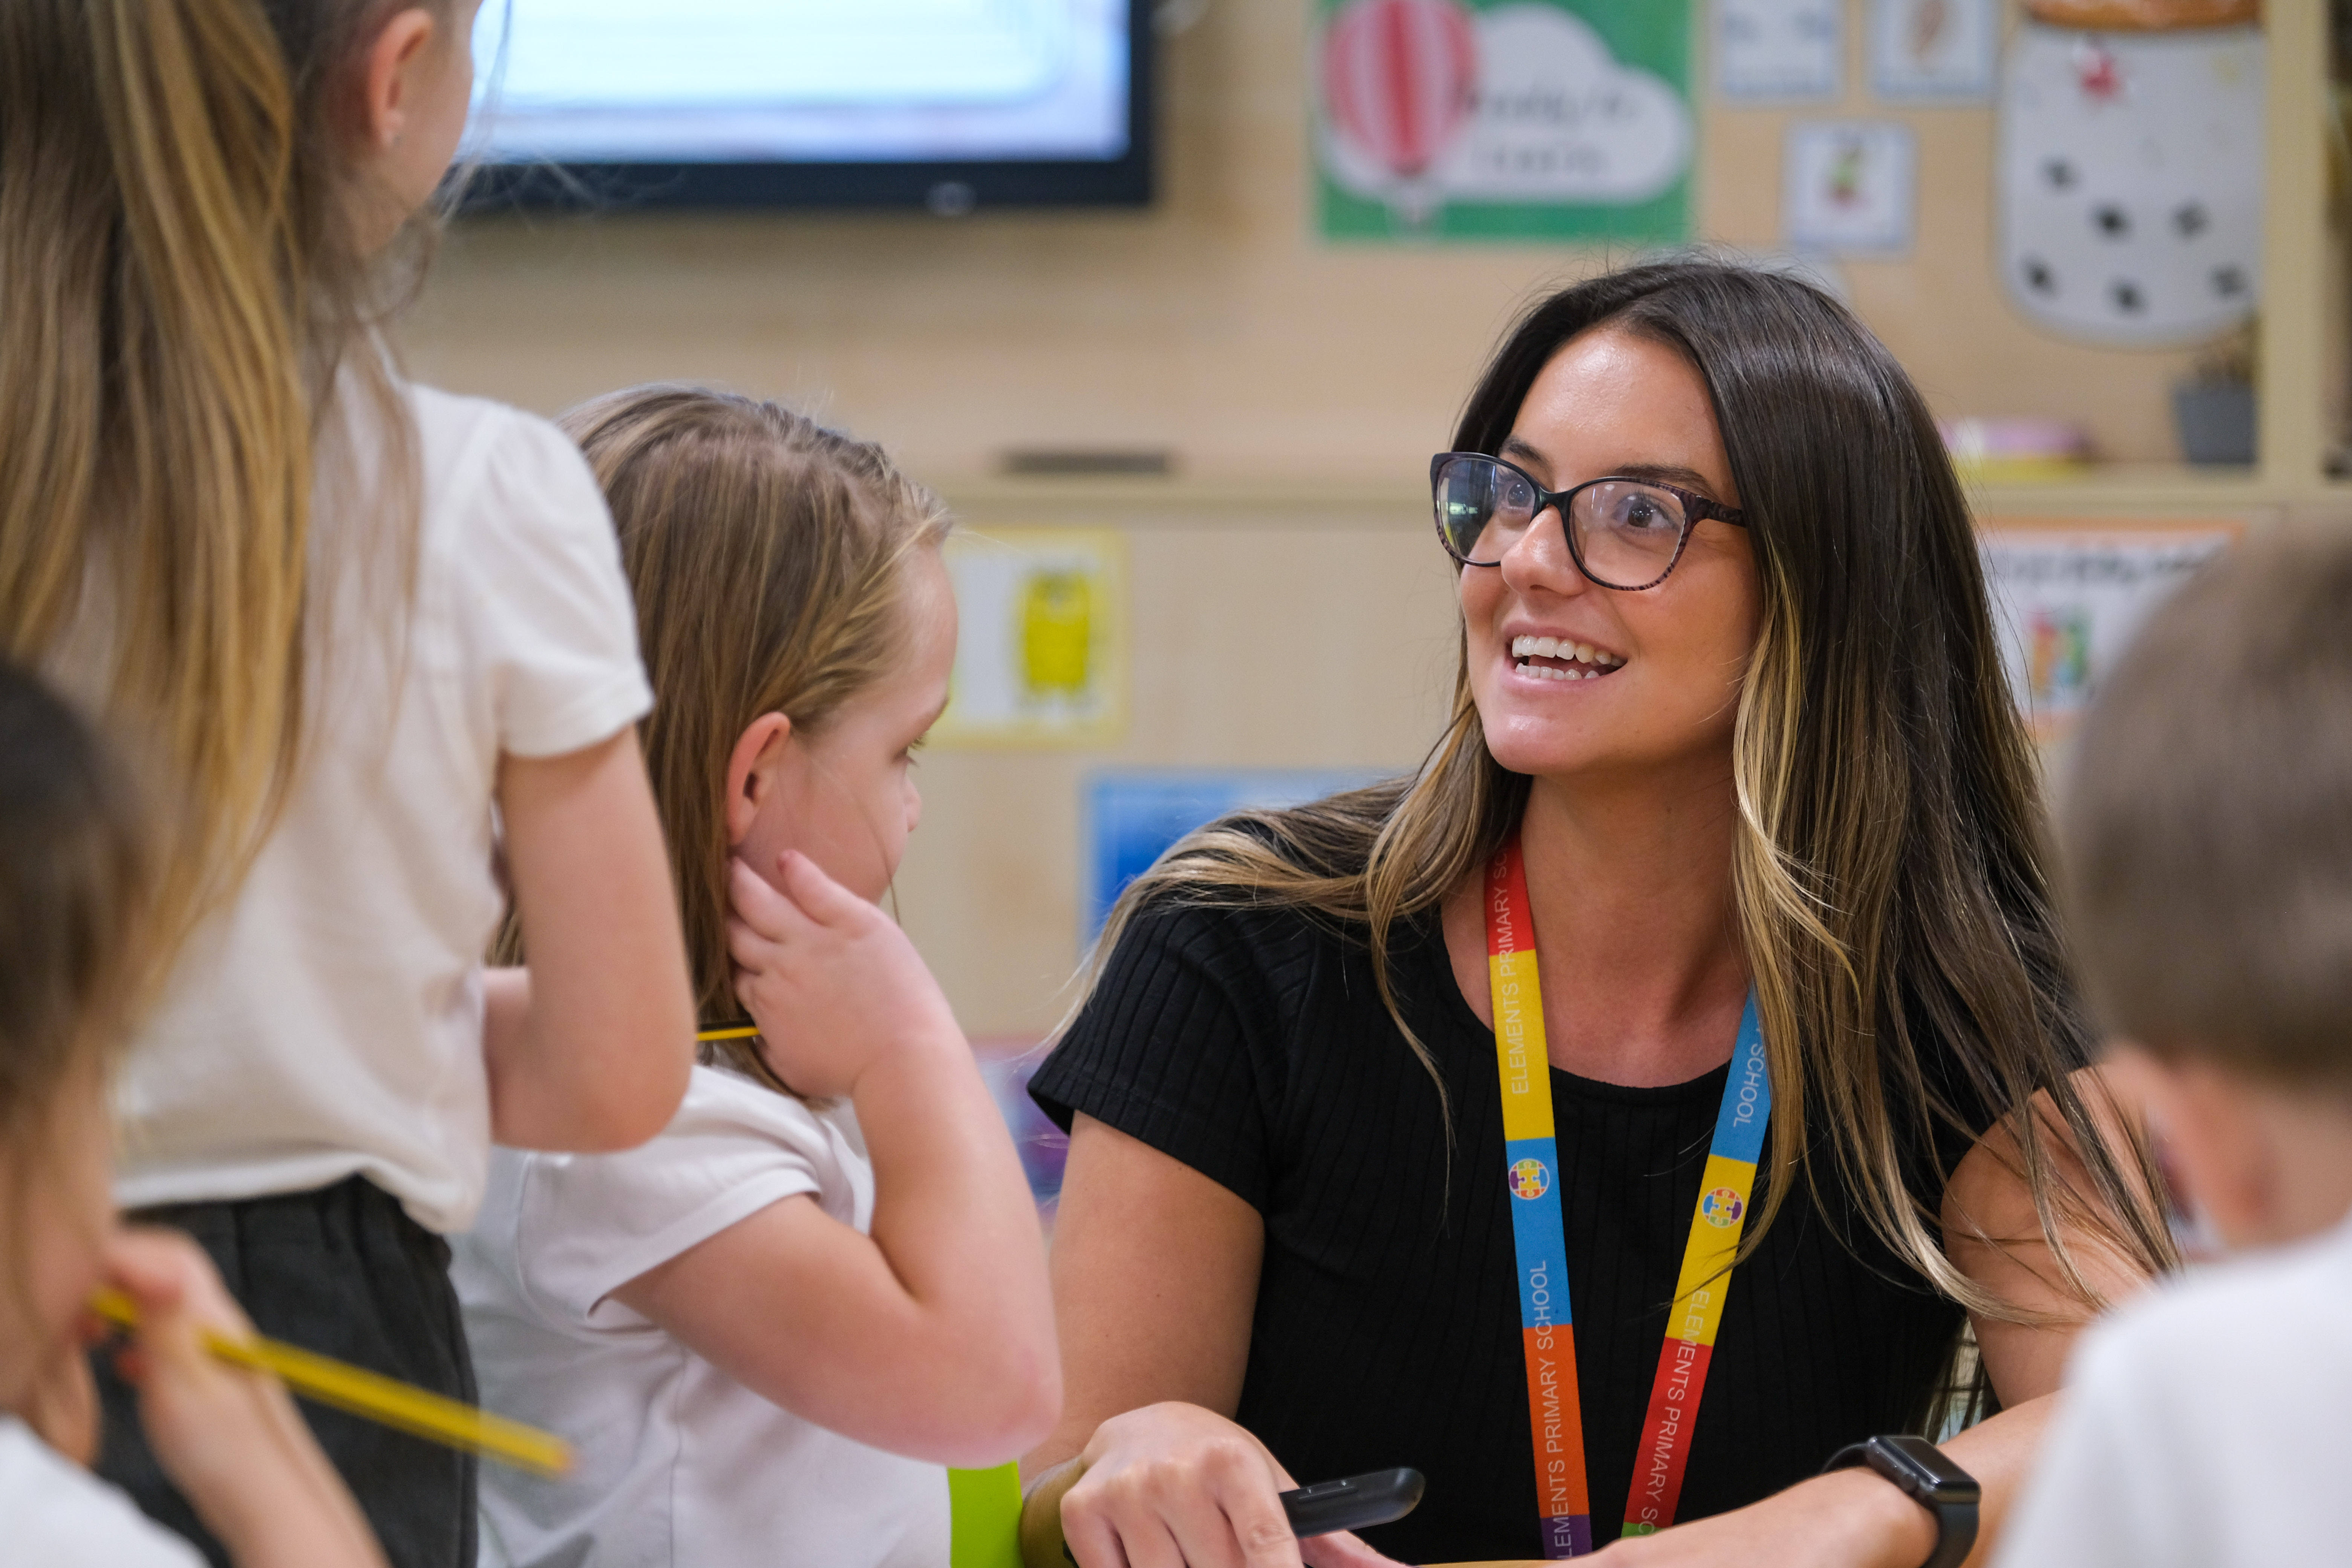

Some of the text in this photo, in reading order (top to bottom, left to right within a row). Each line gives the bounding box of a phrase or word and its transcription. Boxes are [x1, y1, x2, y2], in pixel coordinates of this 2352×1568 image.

[1494, 887, 1517, 977] PRIMARY
[1502, 982, 1529, 1095] ELEMENTS
[1733, 1043, 1765, 1128] SCHOOL
[1668, 1290, 1710, 1401] ELEMENTS
[1530, 1260, 1573, 1559] LEMENTS PRIMARY SCHOOL
[1646, 1406, 1681, 1503] PRIMARY
